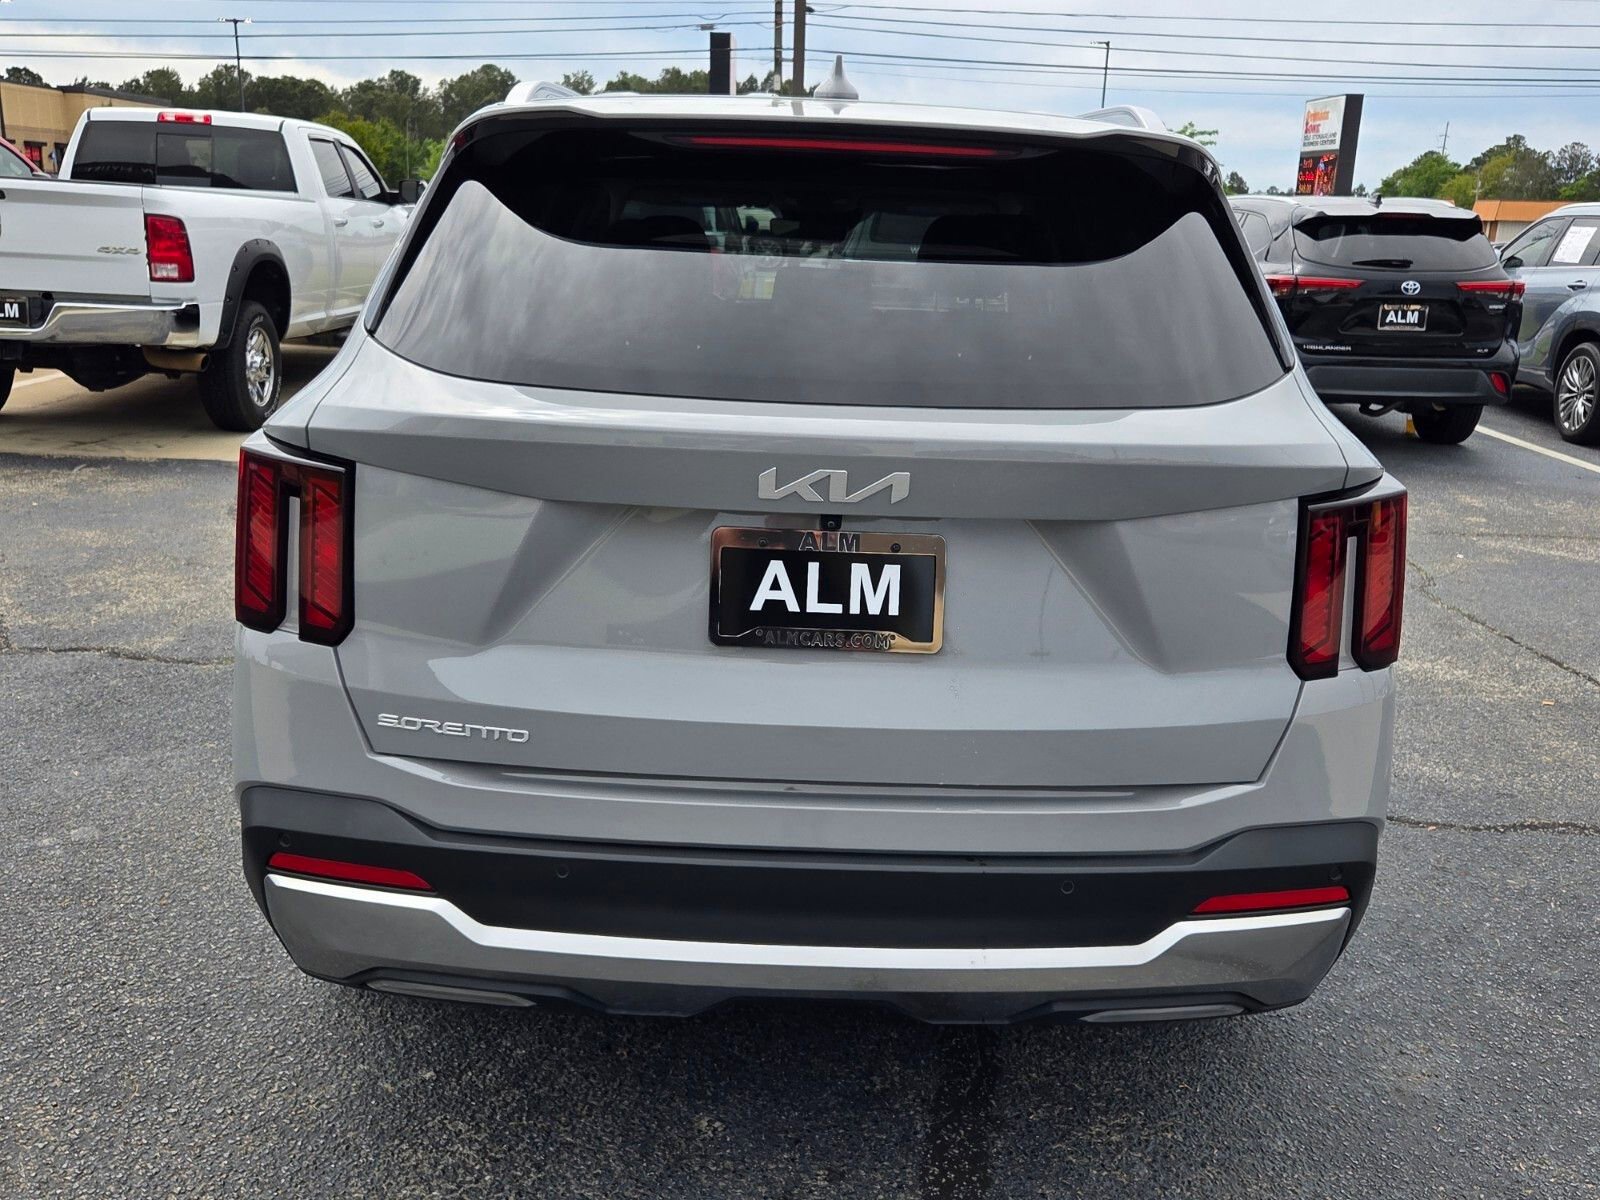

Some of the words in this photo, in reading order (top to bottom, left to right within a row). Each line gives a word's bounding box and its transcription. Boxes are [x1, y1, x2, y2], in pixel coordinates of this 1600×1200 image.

[1385, 310, 1419, 324] ALM
[758, 466, 911, 504] KIA
[799, 531, 860, 553] ALM
[750, 559, 901, 616] ALM
[763, 631, 891, 650] ALMCARS.COM
[377, 713, 530, 744] SORENTO
